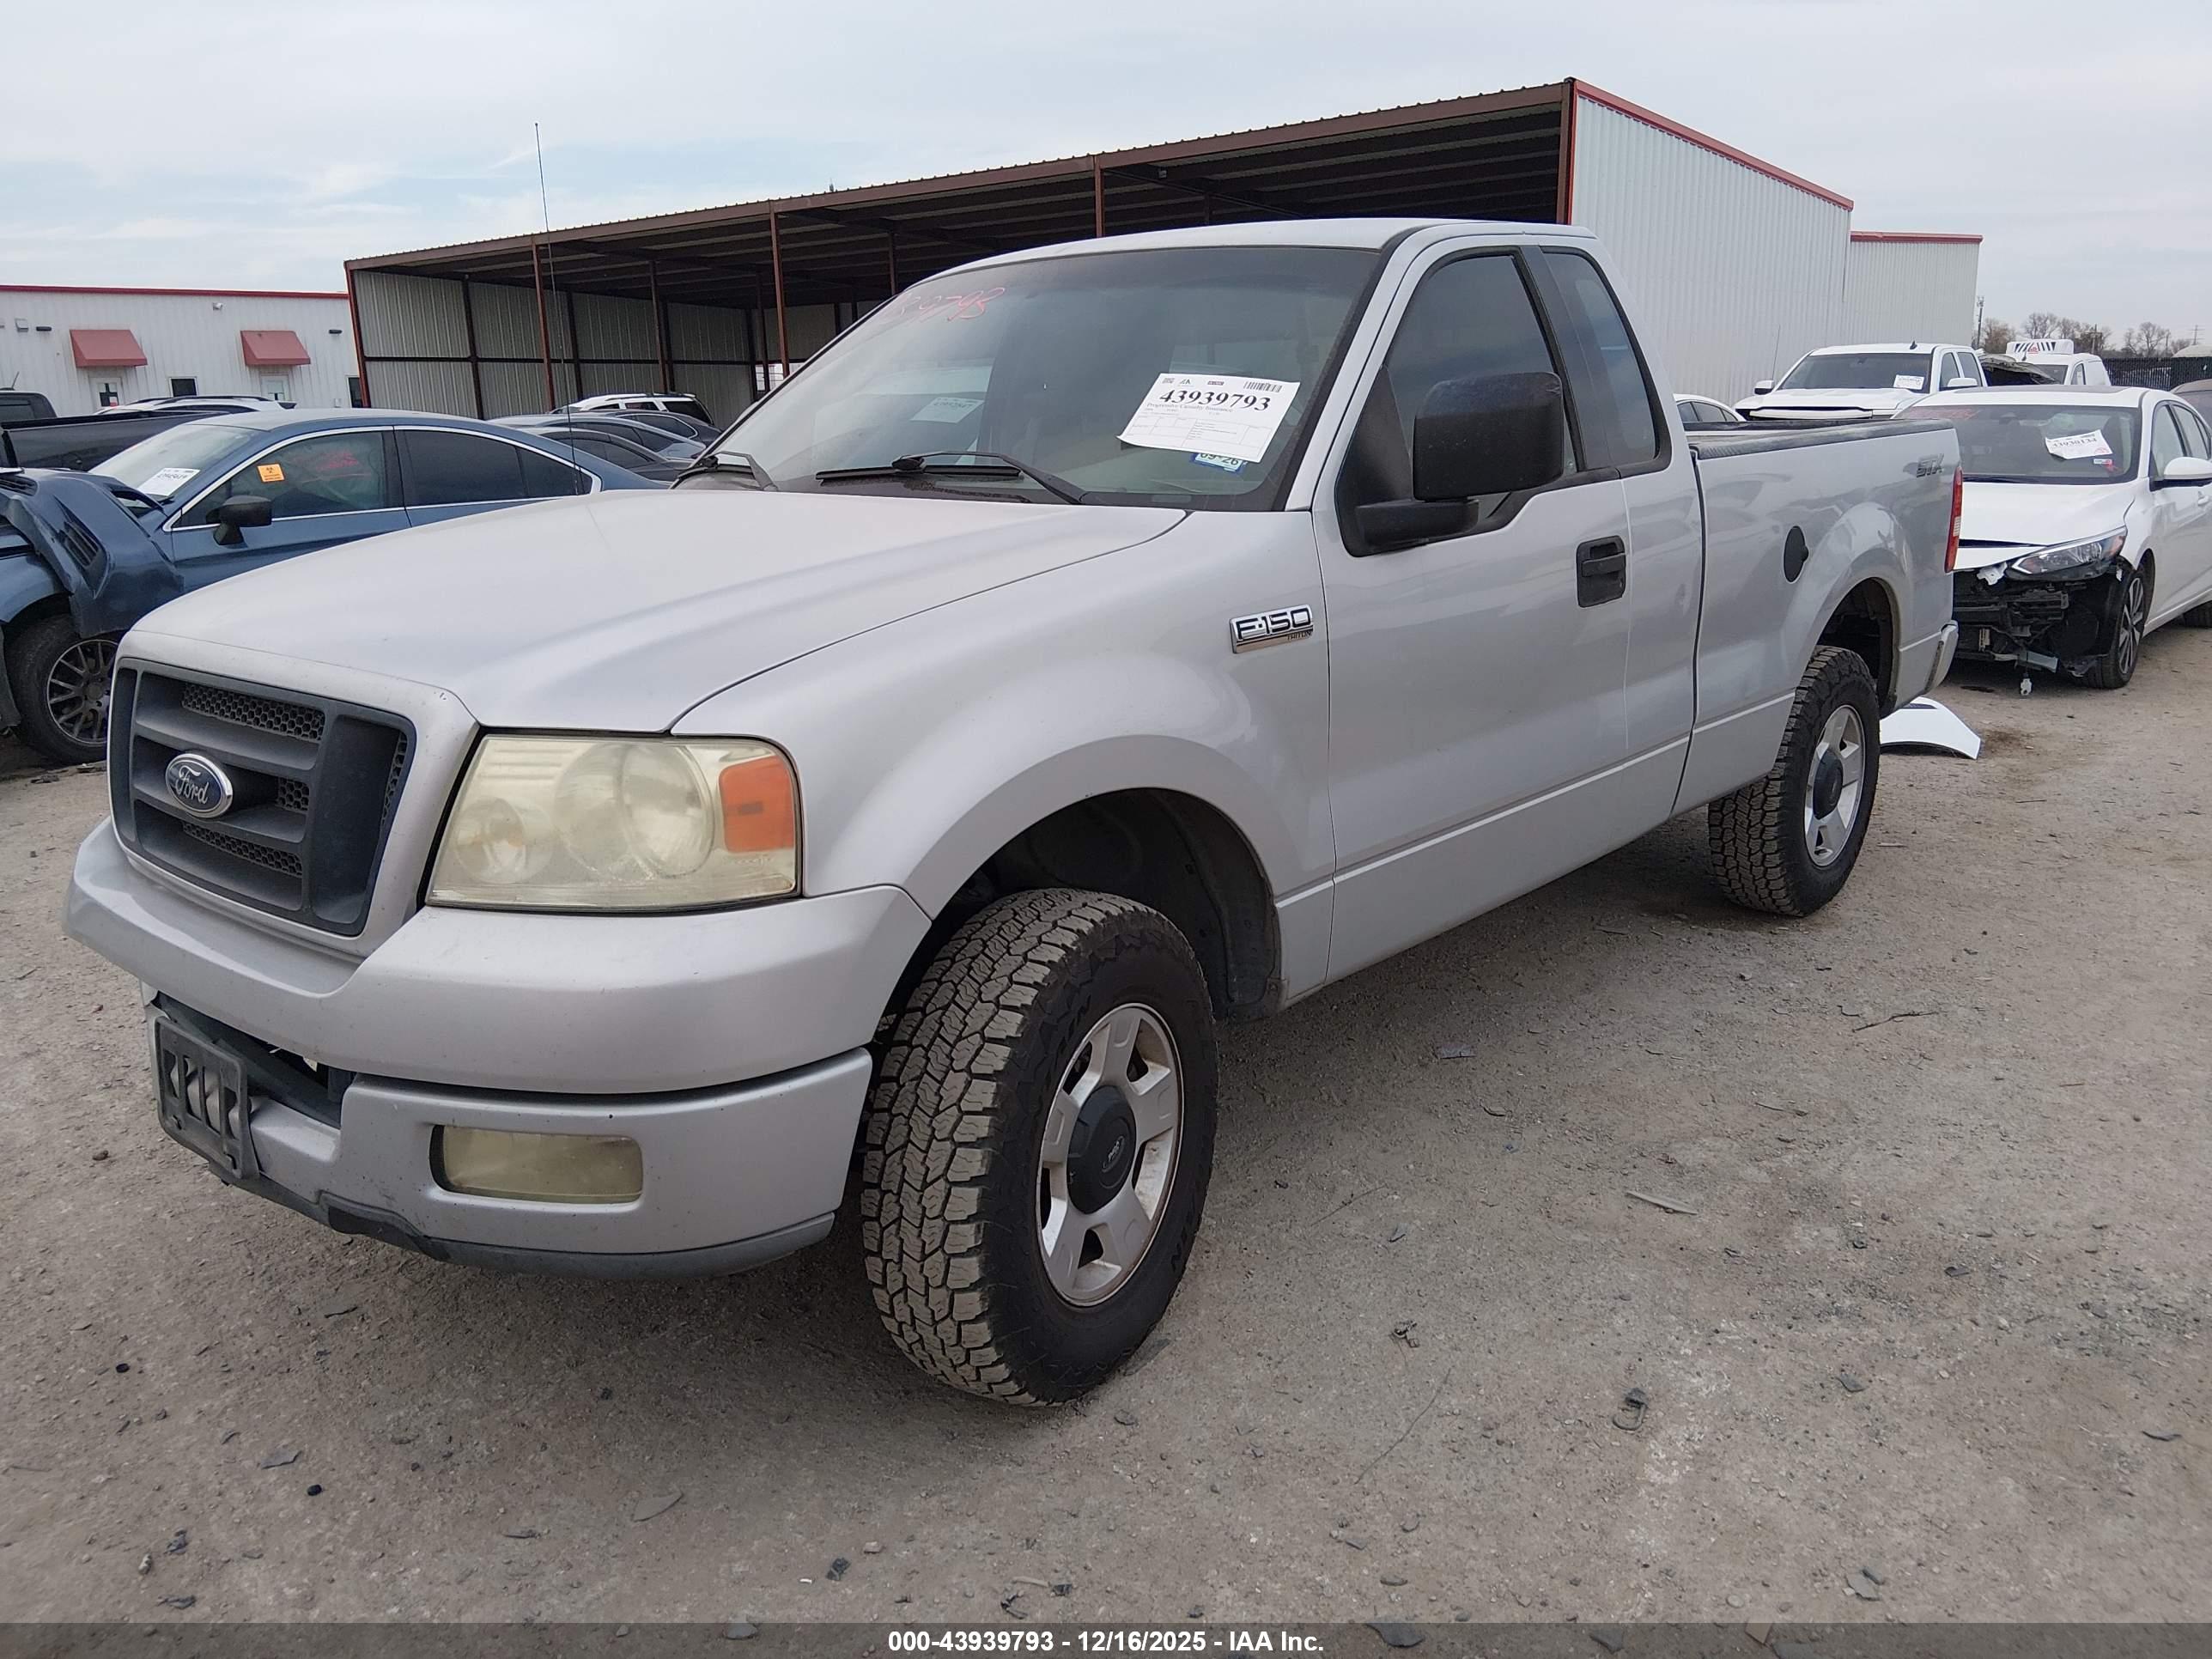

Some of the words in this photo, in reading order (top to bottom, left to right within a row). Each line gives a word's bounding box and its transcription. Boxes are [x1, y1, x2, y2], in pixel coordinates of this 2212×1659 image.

[1159, 389, 1271, 411] 43939793
[1235, 607, 1311, 640] F-150
[175, 765, 209, 805] Ford
